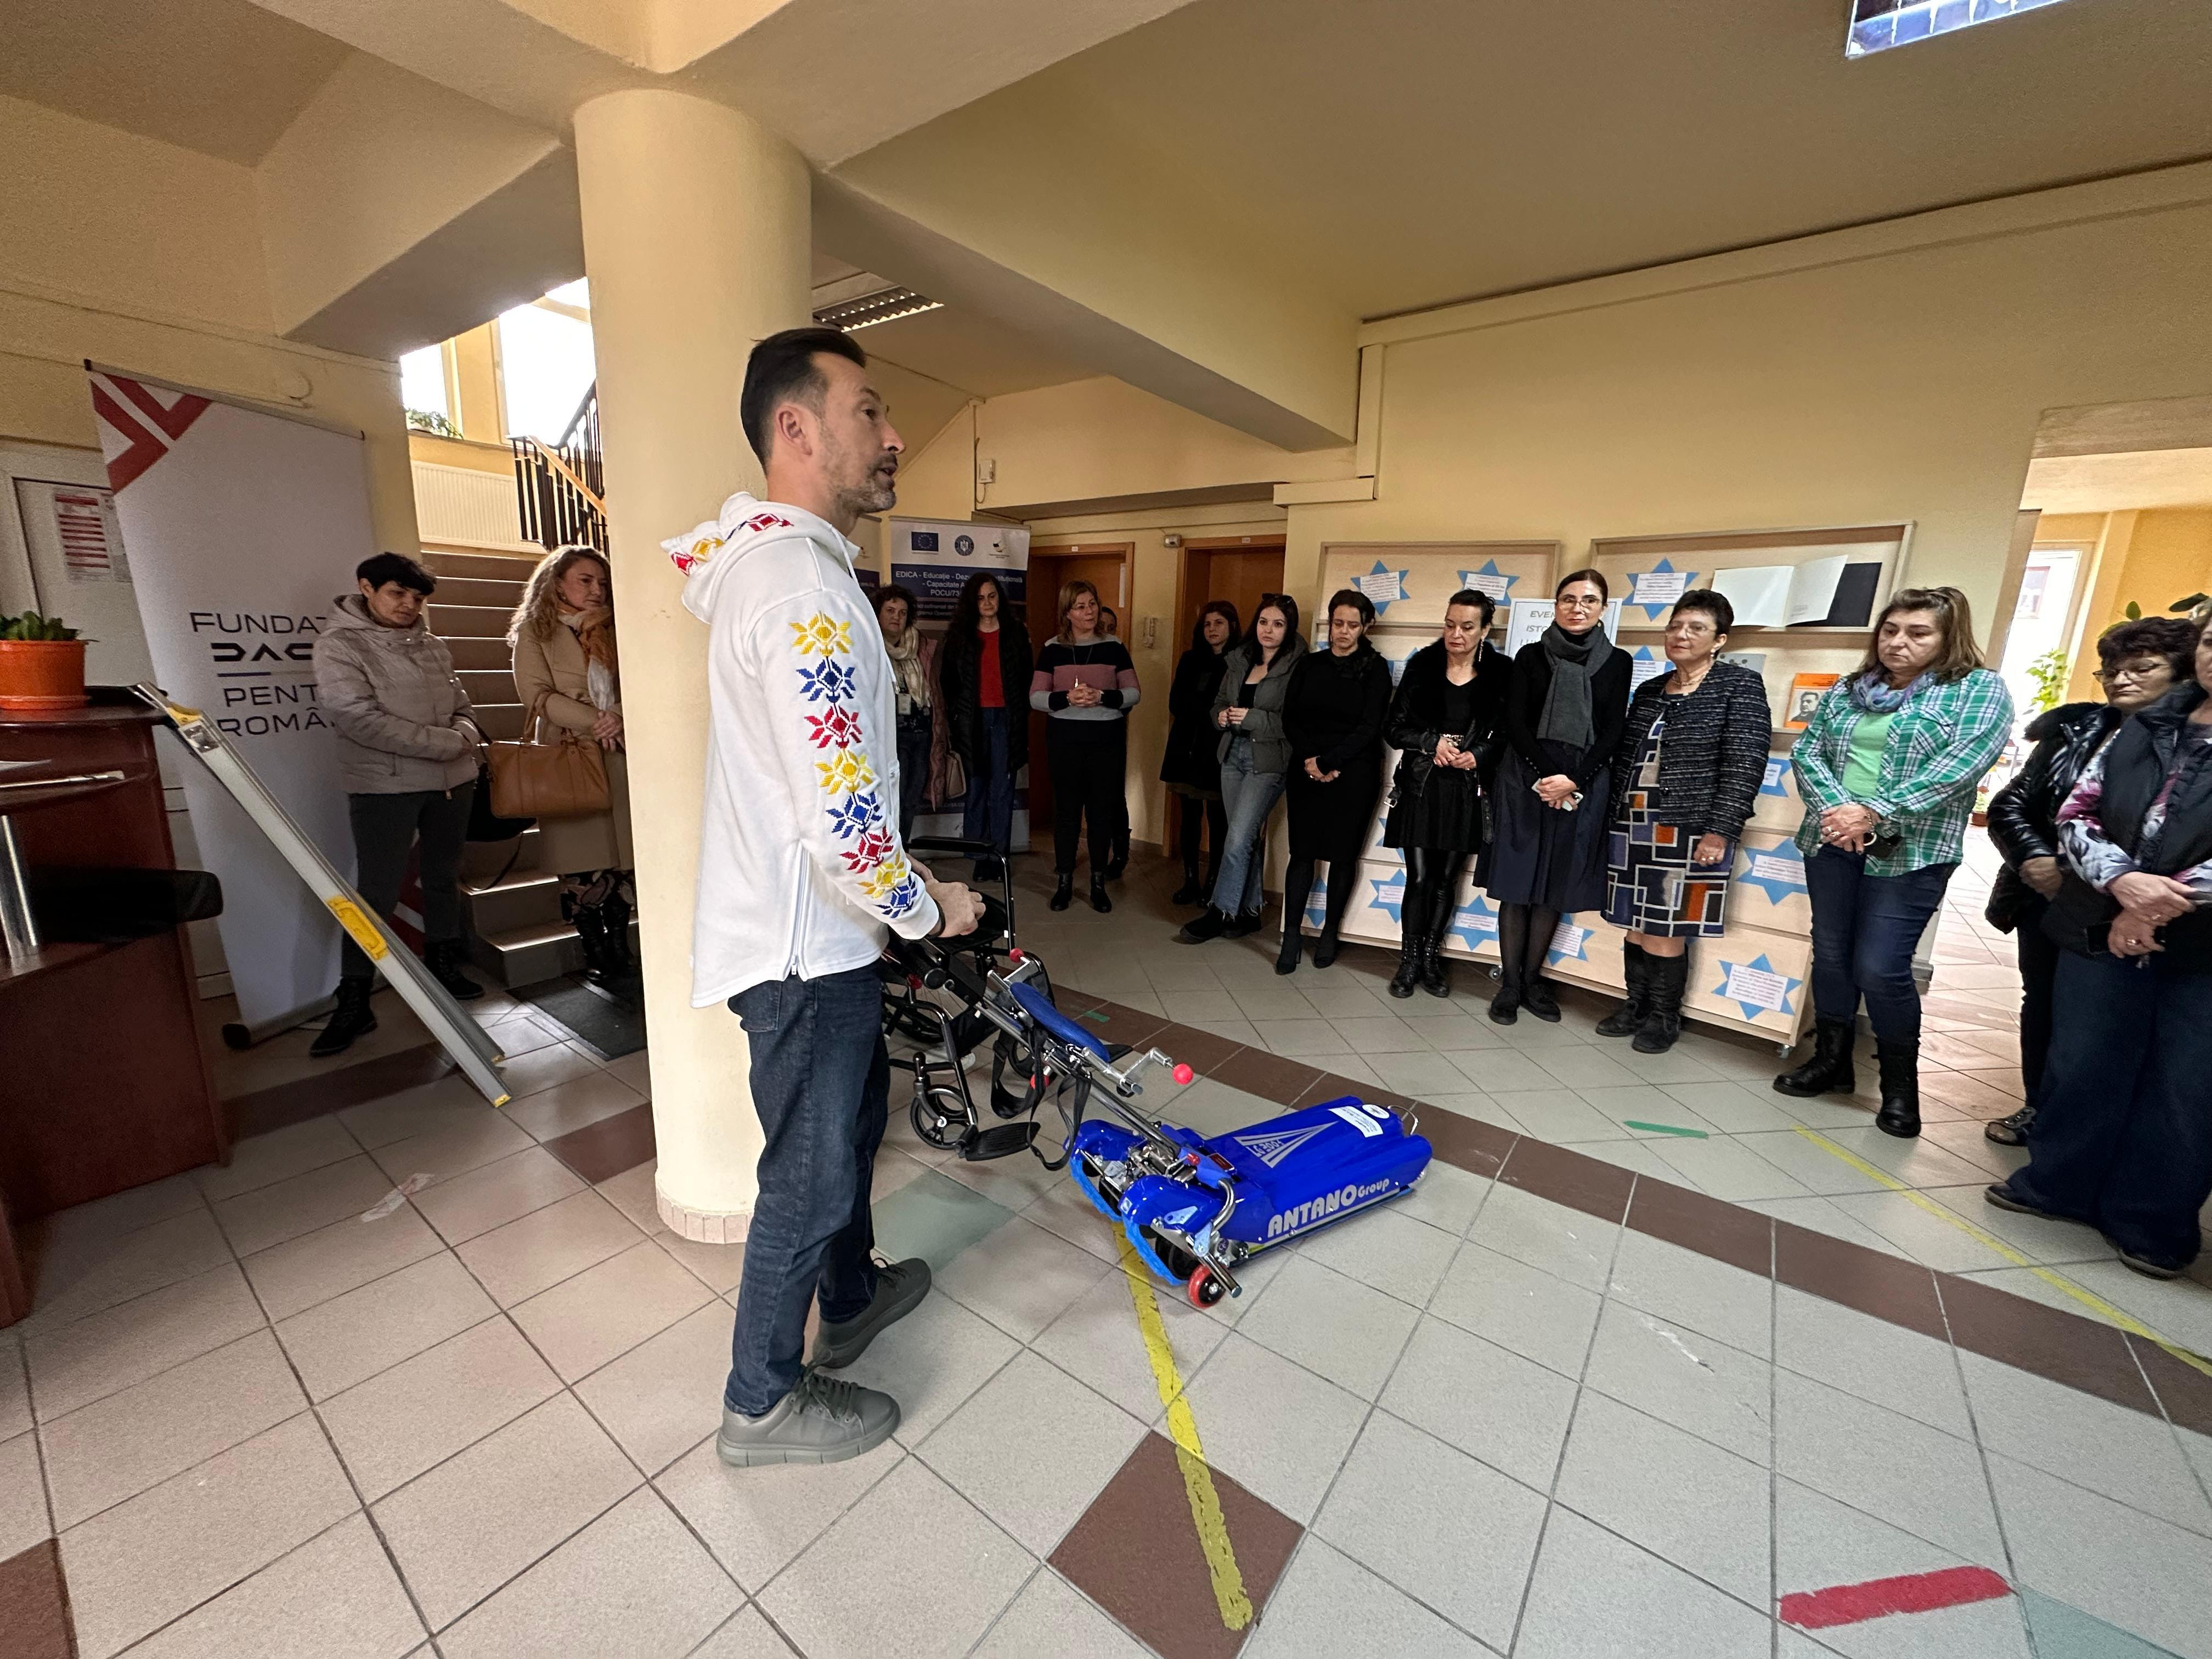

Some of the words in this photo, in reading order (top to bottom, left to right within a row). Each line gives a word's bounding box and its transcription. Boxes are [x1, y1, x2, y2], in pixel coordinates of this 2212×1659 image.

[223, 684, 319, 708] PENT
[217, 707, 336, 736] ROMÂ
[1267, 1184, 1357, 1238] ANTANO
[1357, 1178, 1390, 1198] Group
